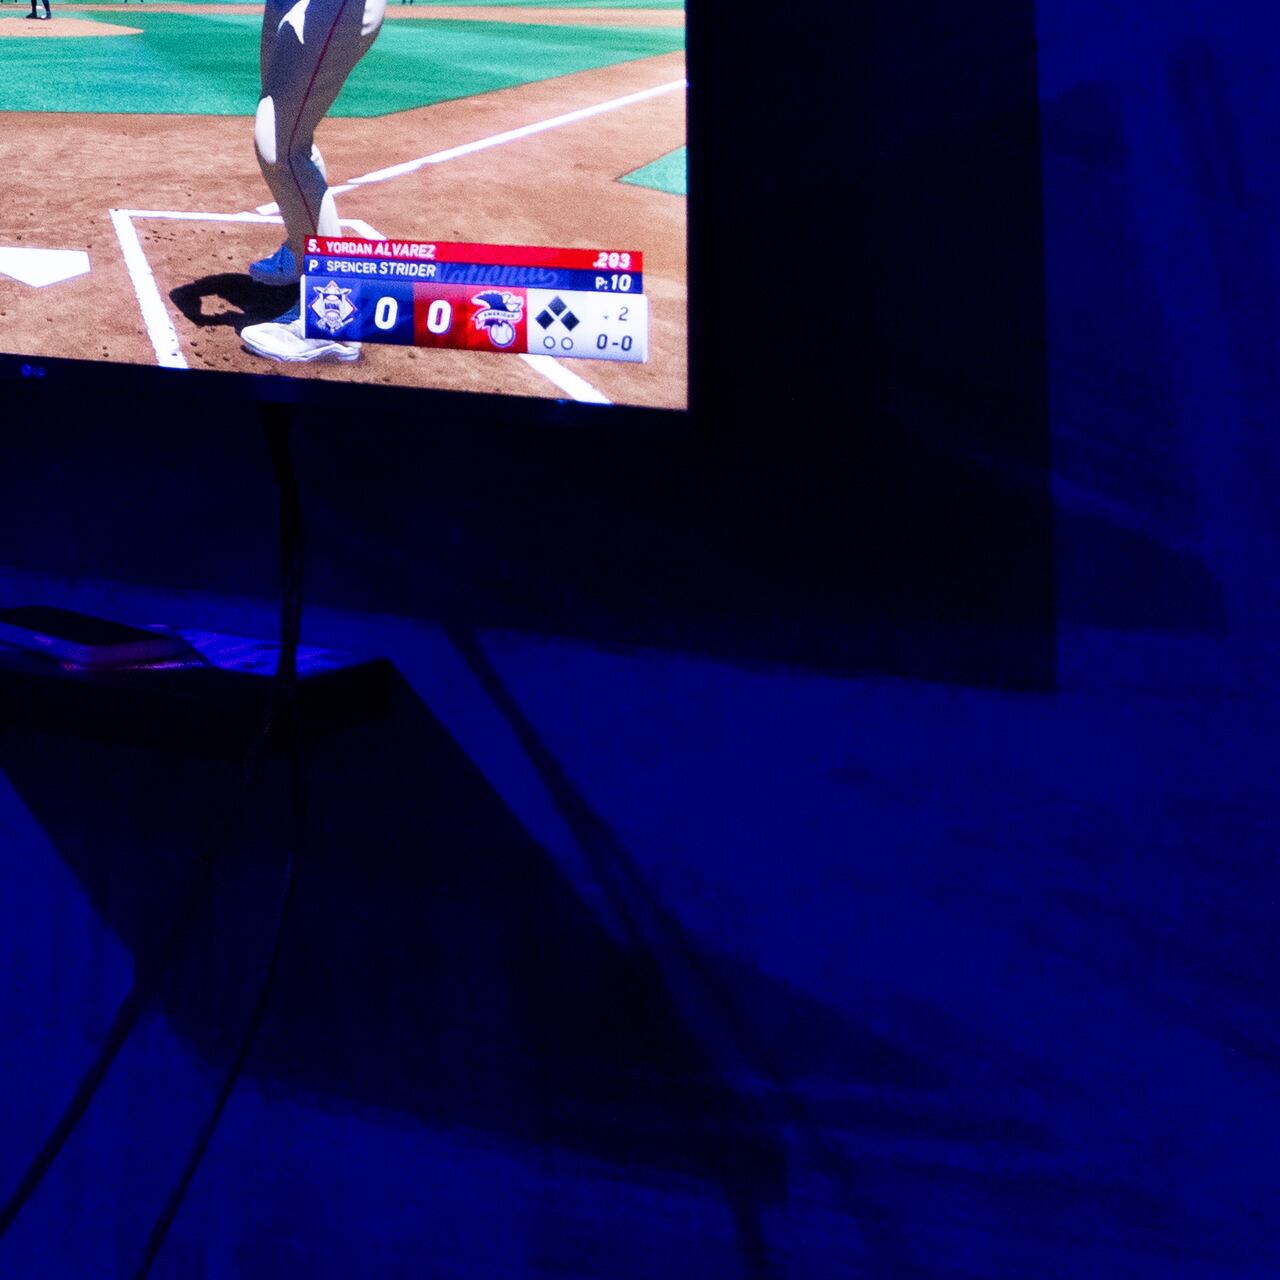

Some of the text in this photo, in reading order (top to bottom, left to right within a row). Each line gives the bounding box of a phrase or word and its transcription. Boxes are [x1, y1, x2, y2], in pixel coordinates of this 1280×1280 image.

[307, 239, 321, 253] 5.
[326, 241, 372, 255] YORDAN
[374, 243, 436, 258] ALVAREZ
[309, 260, 632, 291] P SPENCER STRIDER P: 10
[375, 296, 398, 330] 0
[427, 299, 452, 334] 0
[618, 306, 629, 321] 2
